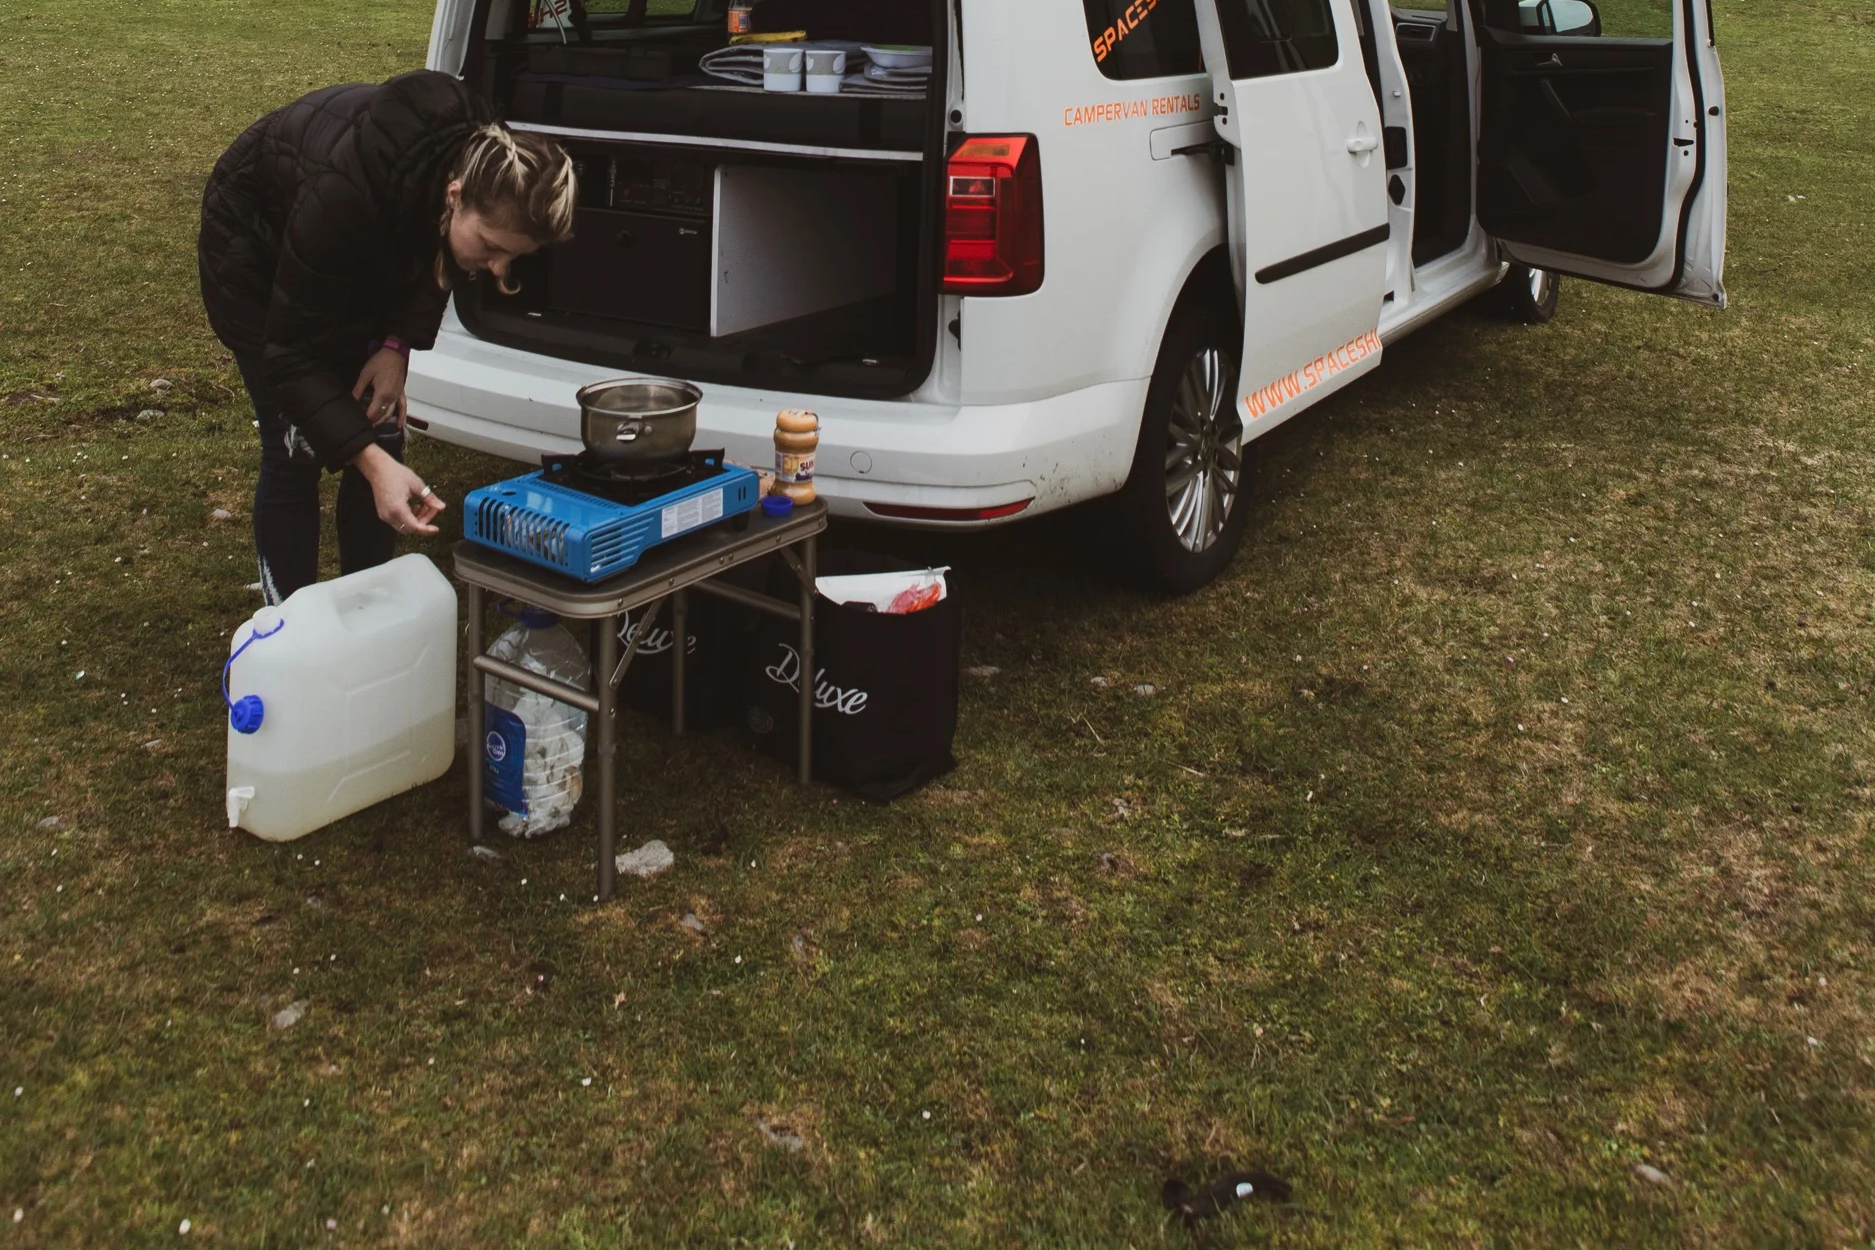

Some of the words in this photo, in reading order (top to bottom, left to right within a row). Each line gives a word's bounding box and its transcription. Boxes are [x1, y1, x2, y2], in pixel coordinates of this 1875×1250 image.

[1064, 99, 1148, 126] CAMPERVAN
[1151, 93, 1200, 116] RENTALS
[1244, 327, 1382, 419] WWW.SPACESHI
